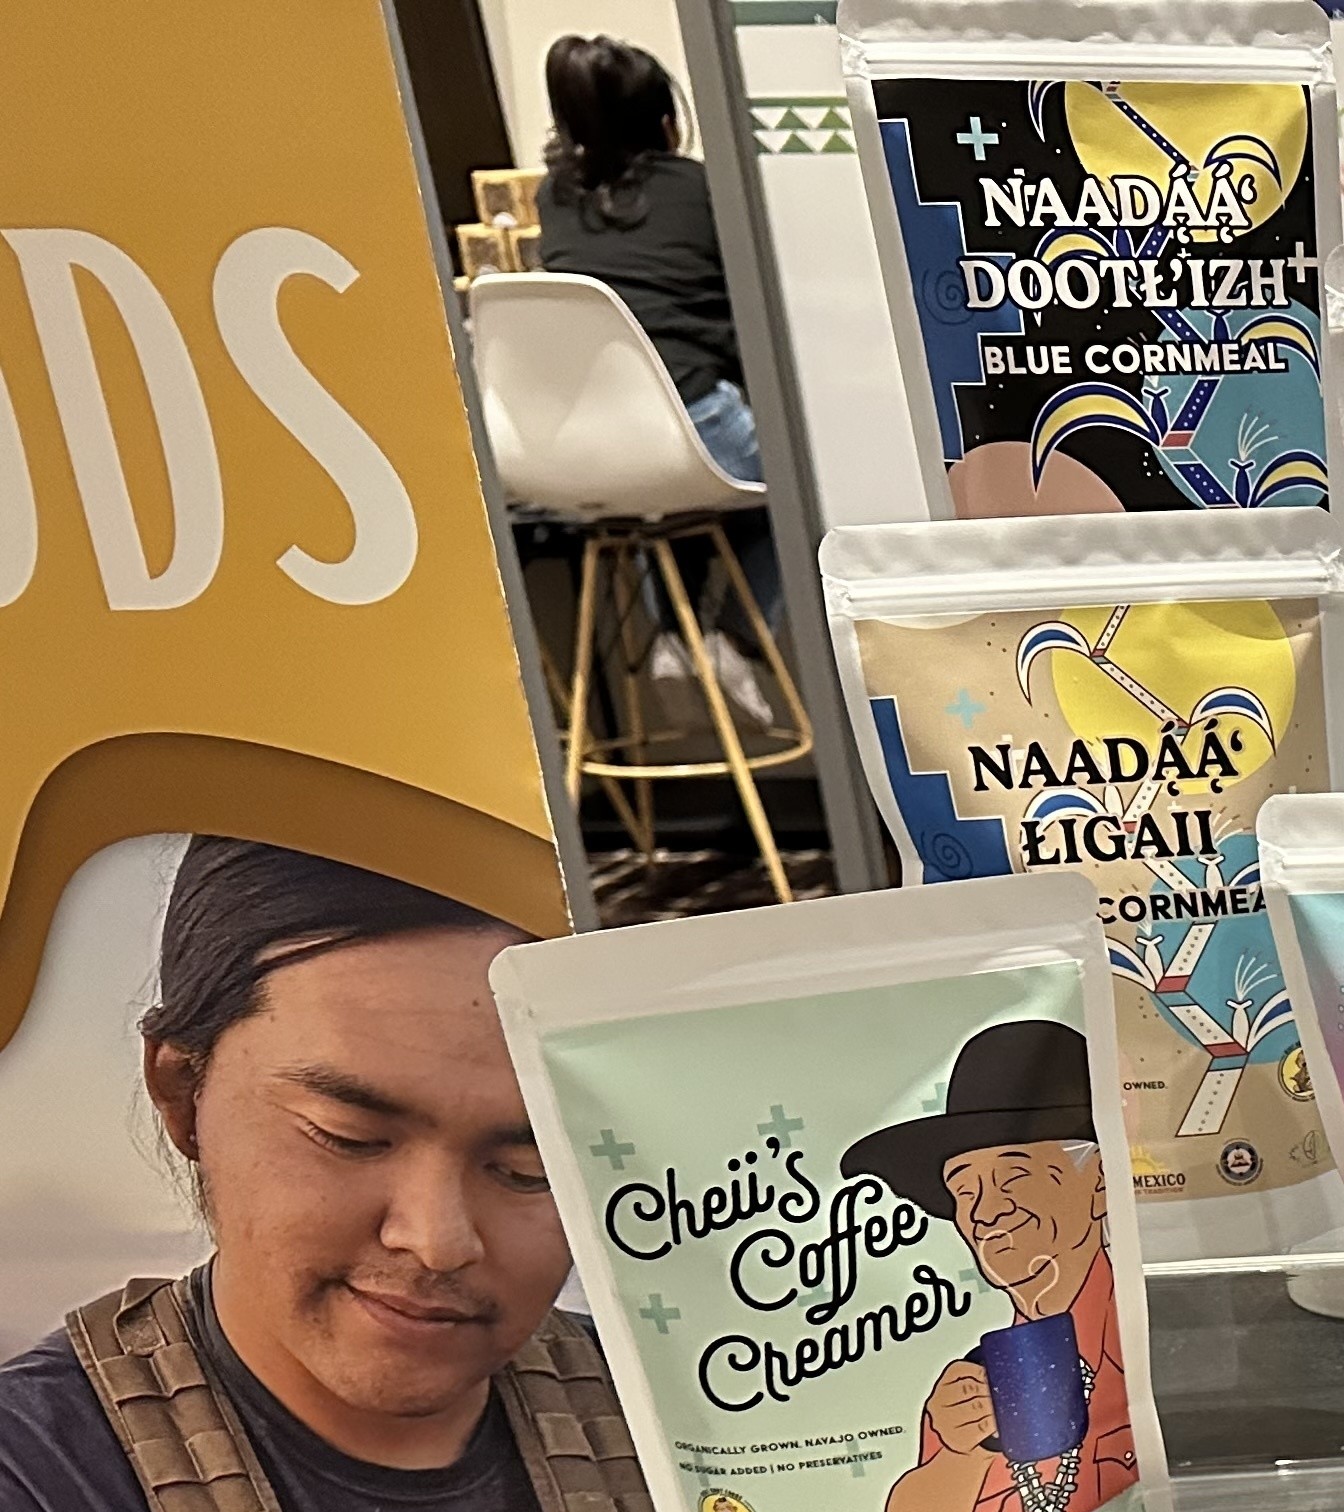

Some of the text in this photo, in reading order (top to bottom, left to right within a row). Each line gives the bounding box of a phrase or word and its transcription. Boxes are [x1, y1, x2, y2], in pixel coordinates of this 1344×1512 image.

[0, 226, 418, 610] DS
[986, 343, 1286, 374] BLUE CORNMEAL
[606, 1136, 820, 1260] Cheii's
[1134, 1173, 1185, 1188] MEXICO
[730, 1177, 928, 1324] Coffee
[700, 1266, 971, 1411] Creamer
[675, 1441, 746, 1455] ORGANICALLY
[805, 1434, 854, 1447] NAVAJO
